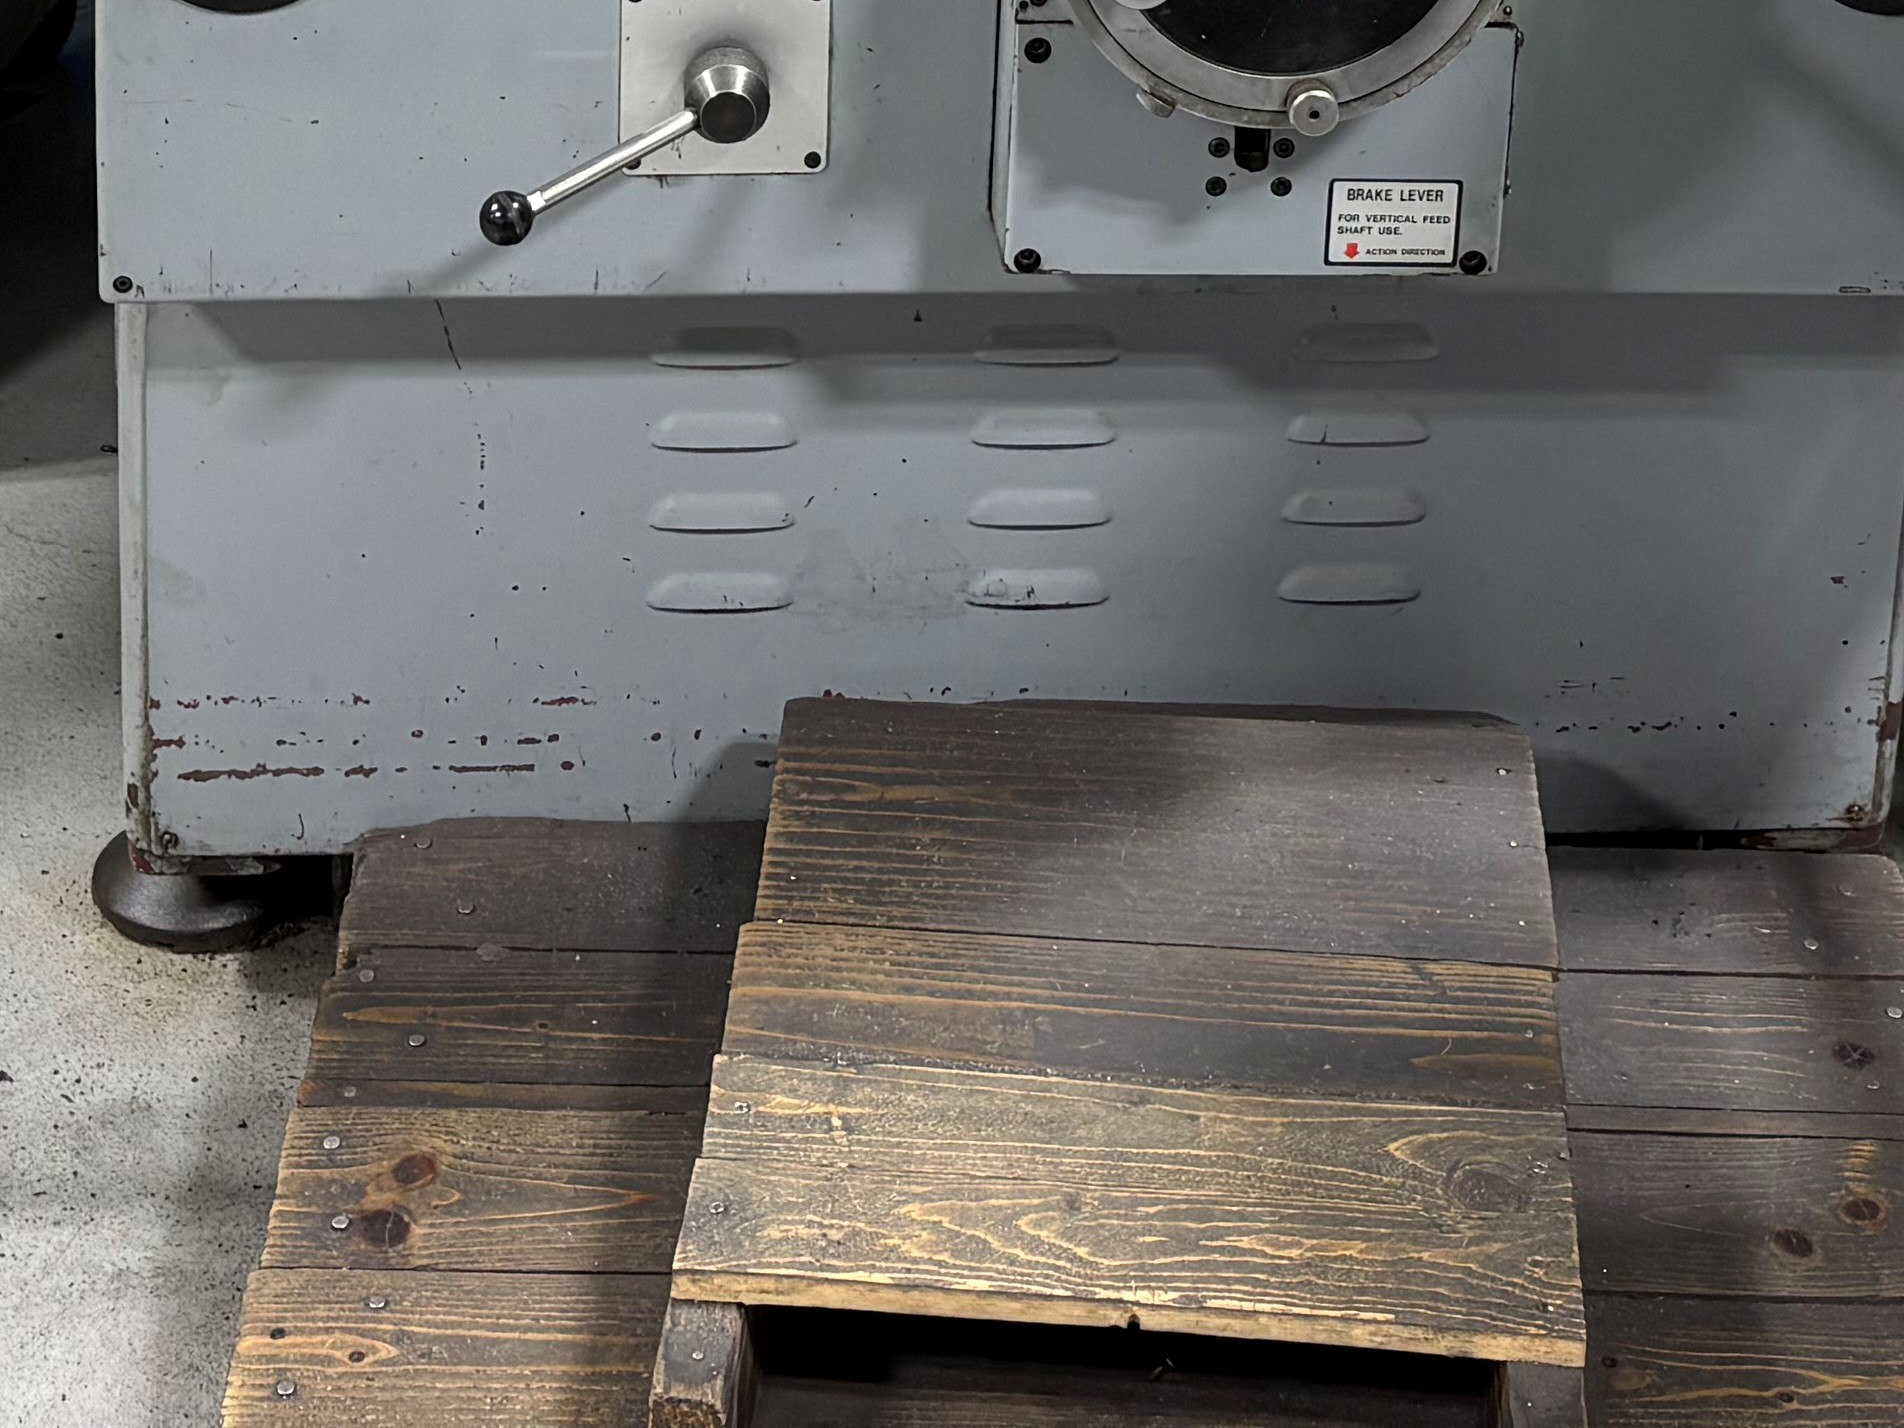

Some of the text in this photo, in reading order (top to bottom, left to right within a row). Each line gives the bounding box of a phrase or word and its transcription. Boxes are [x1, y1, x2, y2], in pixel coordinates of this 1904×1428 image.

[1346, 188, 1444, 202] BRAKE LEVER
[1338, 213, 1451, 224] FOR VERTICAL FEED
[1337, 226, 1373, 235] SHAFT
[1401, 248, 1445, 256] DIRECTION
